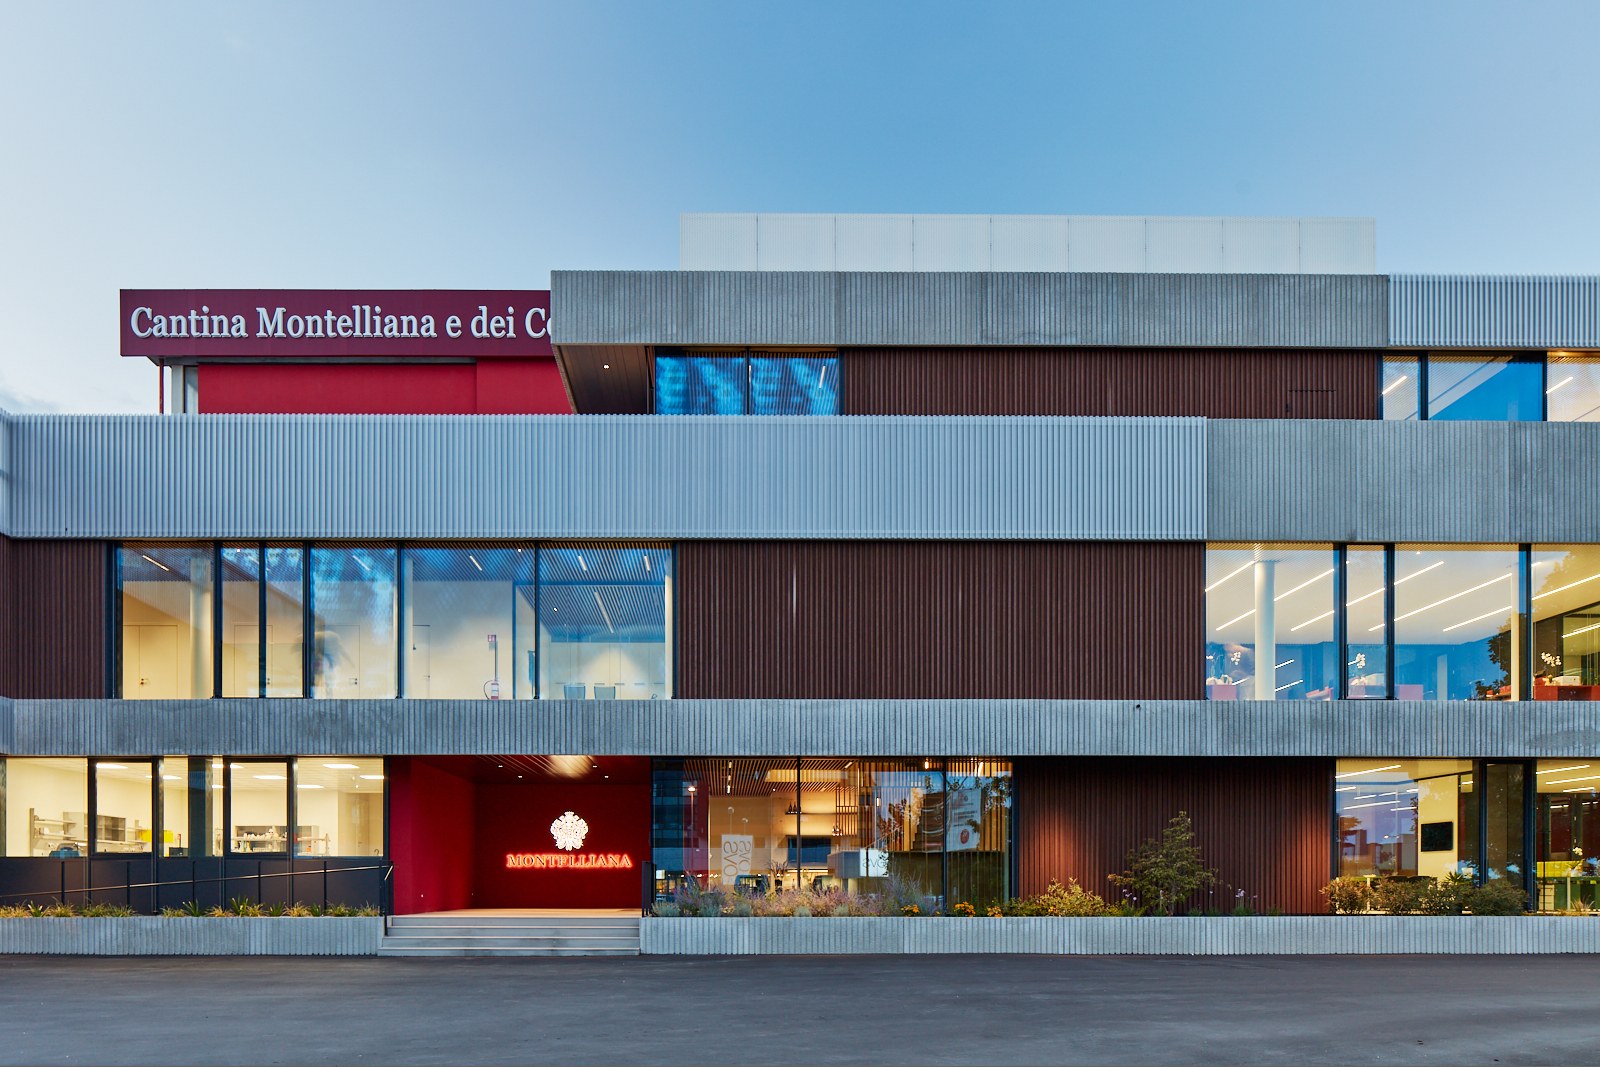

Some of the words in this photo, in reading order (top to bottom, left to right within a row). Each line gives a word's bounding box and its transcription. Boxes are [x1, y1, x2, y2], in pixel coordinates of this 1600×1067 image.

[131, 306, 248, 338] Cantina
[256, 305, 437, 338] Montelliana
[445, 314, 462, 338] e
[470, 305, 516, 338] dei
[506, 854, 632, 868] MONTELLIANA
